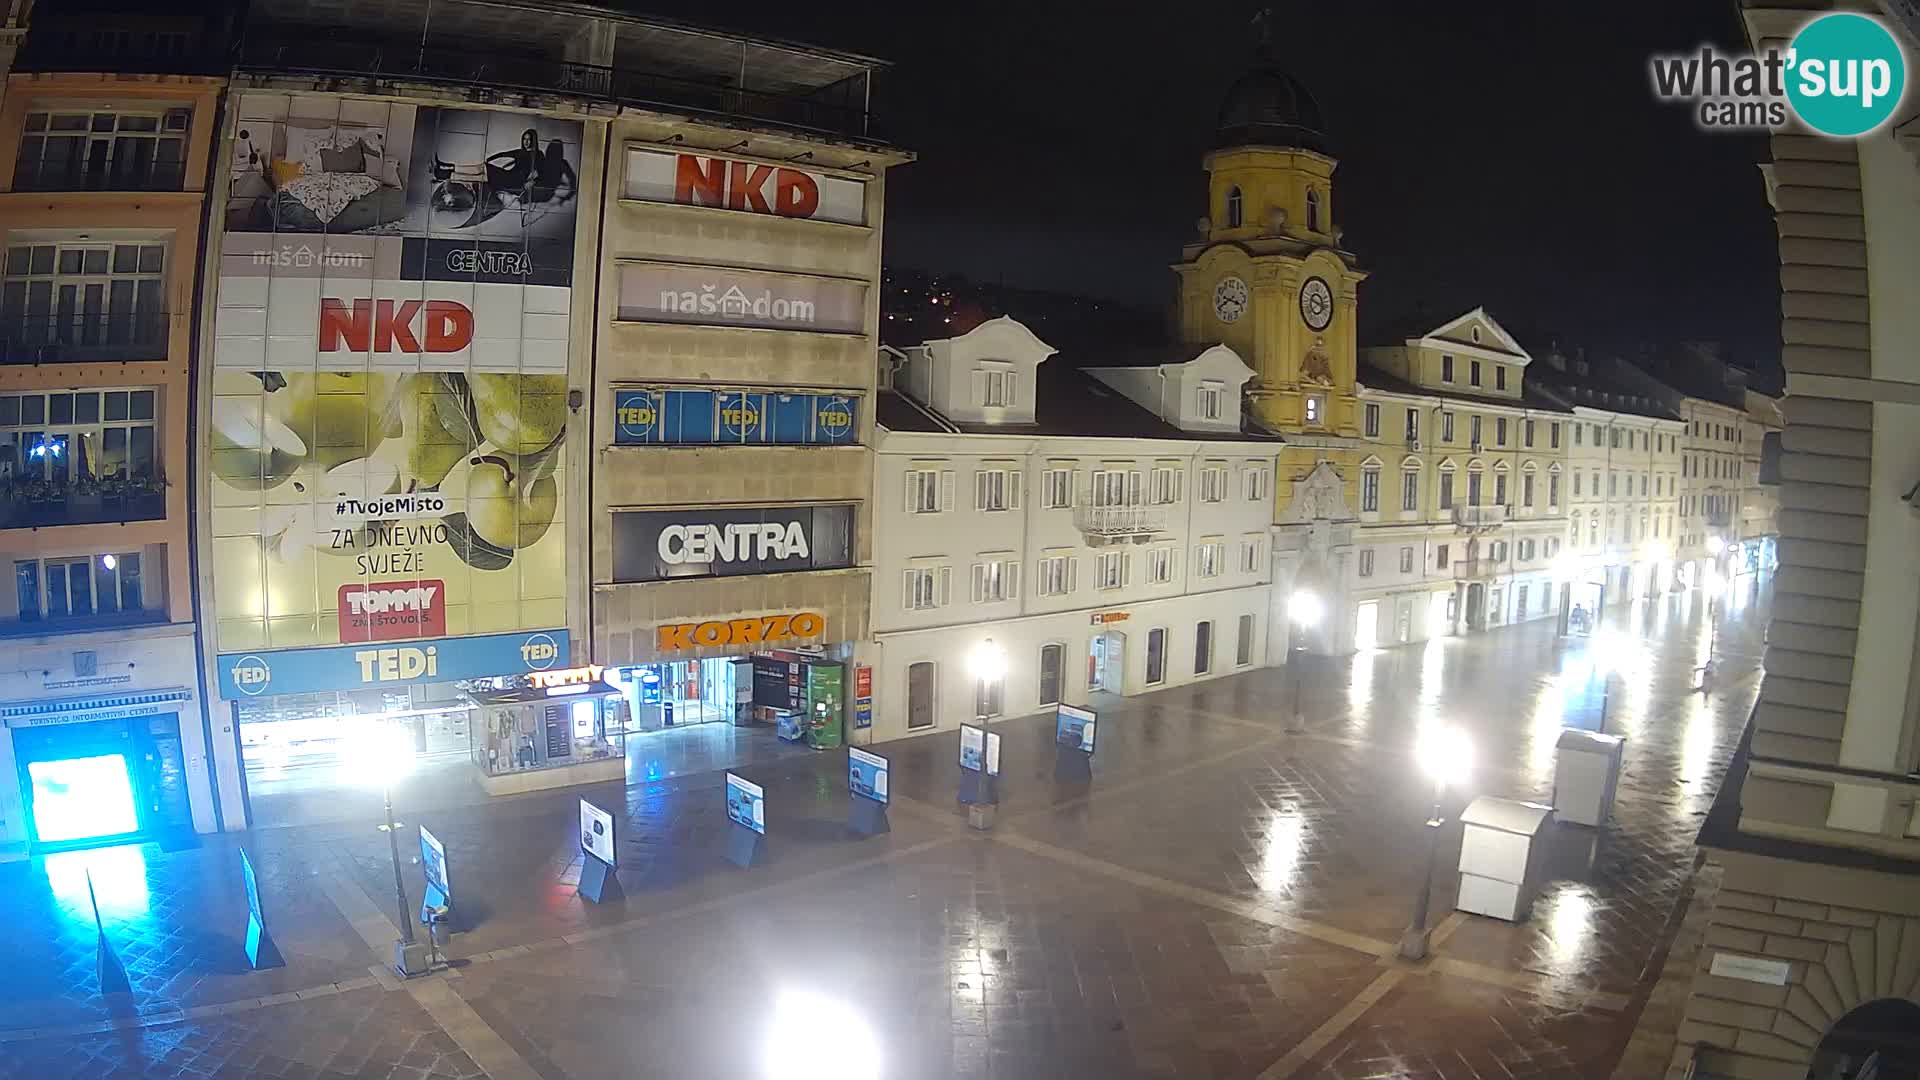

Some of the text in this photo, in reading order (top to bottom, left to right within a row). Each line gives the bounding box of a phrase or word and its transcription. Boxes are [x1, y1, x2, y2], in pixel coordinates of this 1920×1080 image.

[675, 154, 820, 218] NKD
[252, 247, 364, 268] naš dom
[446, 249, 534, 275] CENTRA
[660, 284, 816, 323] naš dom
[318, 297, 476, 354] NKD
[336, 497, 444, 517] #TvojeMisto
[331, 524, 448, 549] ZA DNEVNO
[658, 521, 809, 564] CENTRA
[357, 548, 424, 575] SVJEŽE
[346, 586, 437, 615] TOMMY
[656, 612, 825, 651] KORZO
[356, 646, 438, 683] TEDi
[529, 664, 603, 688] TOMMY
